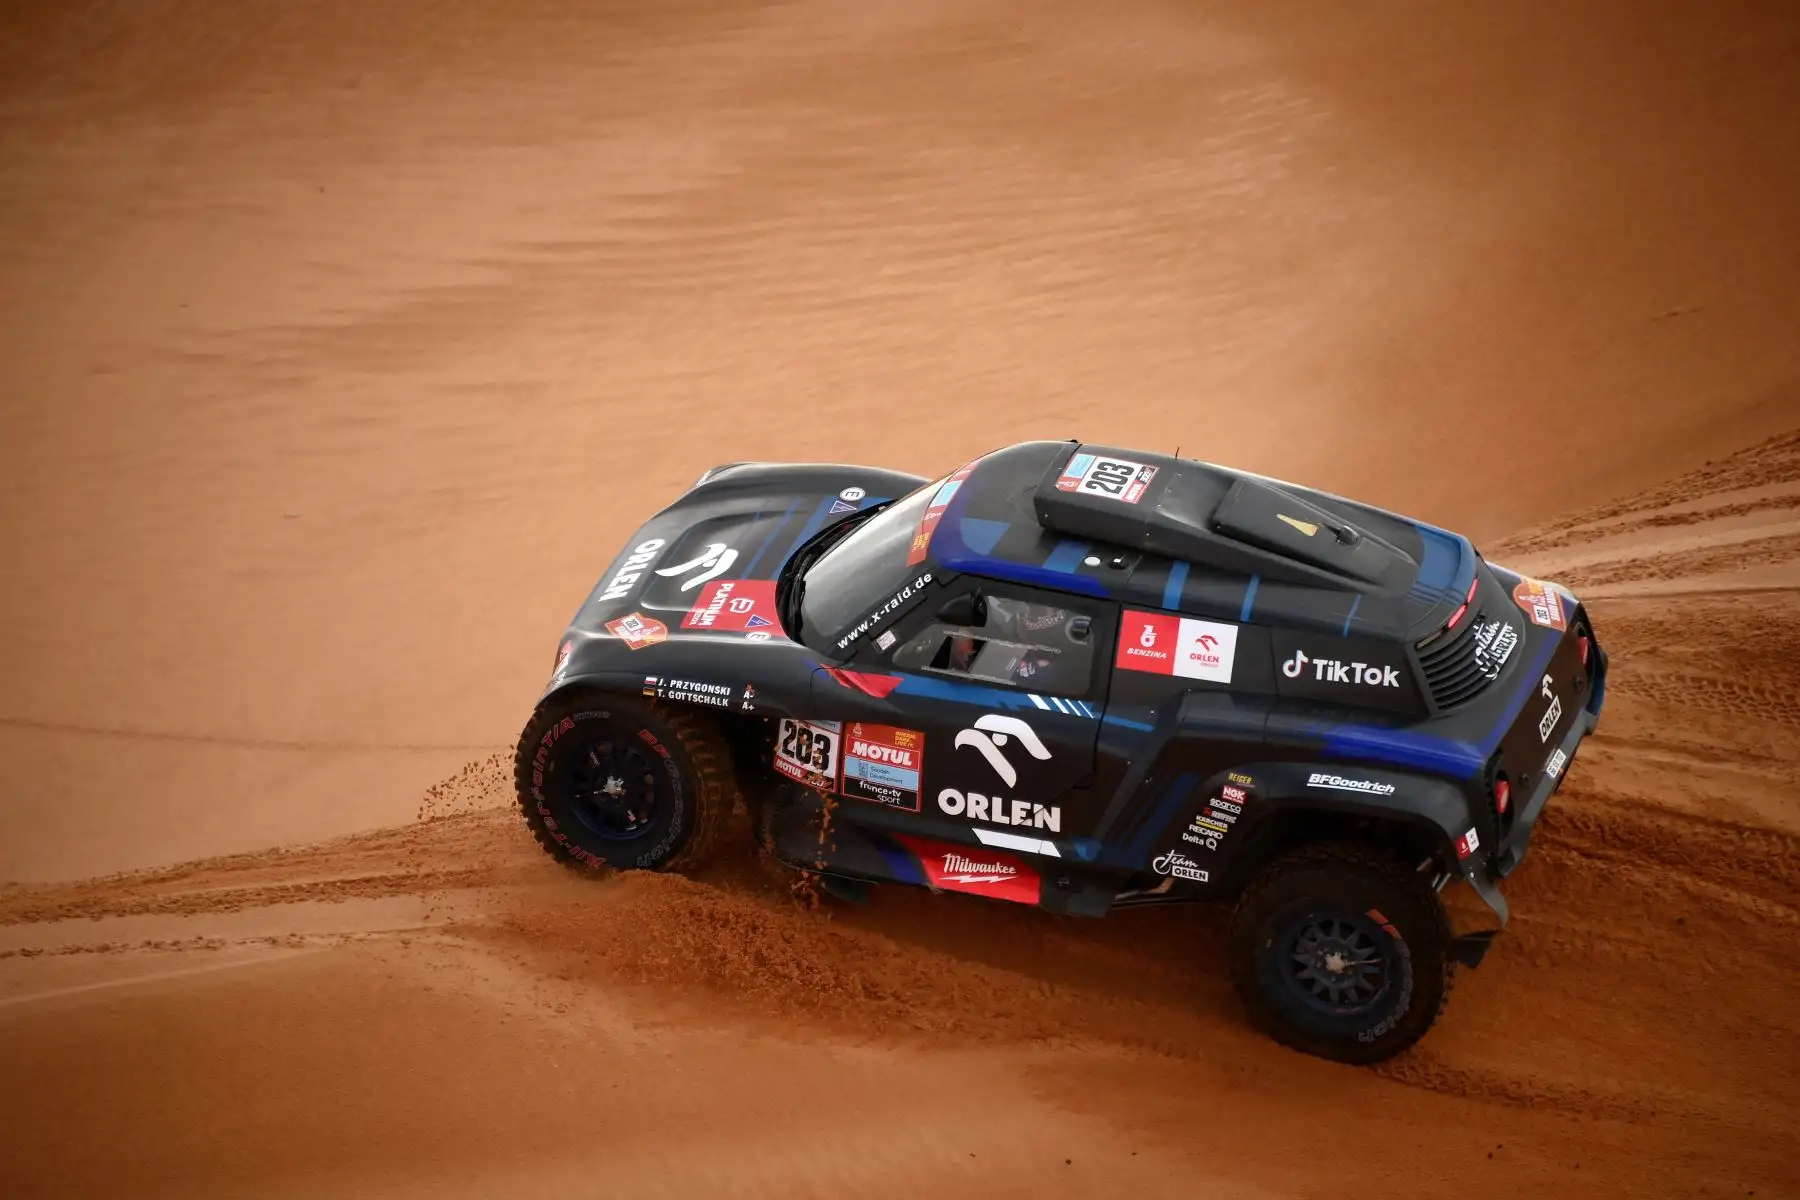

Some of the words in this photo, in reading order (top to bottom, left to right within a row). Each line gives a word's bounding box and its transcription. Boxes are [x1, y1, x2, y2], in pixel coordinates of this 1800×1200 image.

[1085, 461, 1135, 495] 203
[598, 538, 666, 602] ORLEN
[698, 583, 735, 626] PLATINUM
[837, 572, 932, 650] www.x-raid.de
[1127, 648, 1167, 659] BENZINA
[1189, 653, 1220, 663] ORLEN
[1313, 659, 1400, 688] TikTok
[658, 678, 667, 687] J.
[670, 680, 731, 696] PRZYGONSKI
[657, 689, 666, 698] T.
[668, 690, 729, 707] GOTTSCHALK
[1541, 699, 1560, 738] ORLEN
[782, 720, 831, 771] 203
[852, 741, 913, 766] MOTUL
[776, 759, 802, 778] MOTUL
[1223, 785, 1246, 801] NGK
[1308, 773, 1396, 793] BFGoodrich
[877, 794, 901, 805] sport
[937, 788, 1061, 833] ORLEN
[1182, 832, 1205, 846] Delta
[1188, 824, 1223, 840] RECARO
[941, 852, 1017, 874] Milwaukee
[1174, 867, 1207, 880] ORLEN
